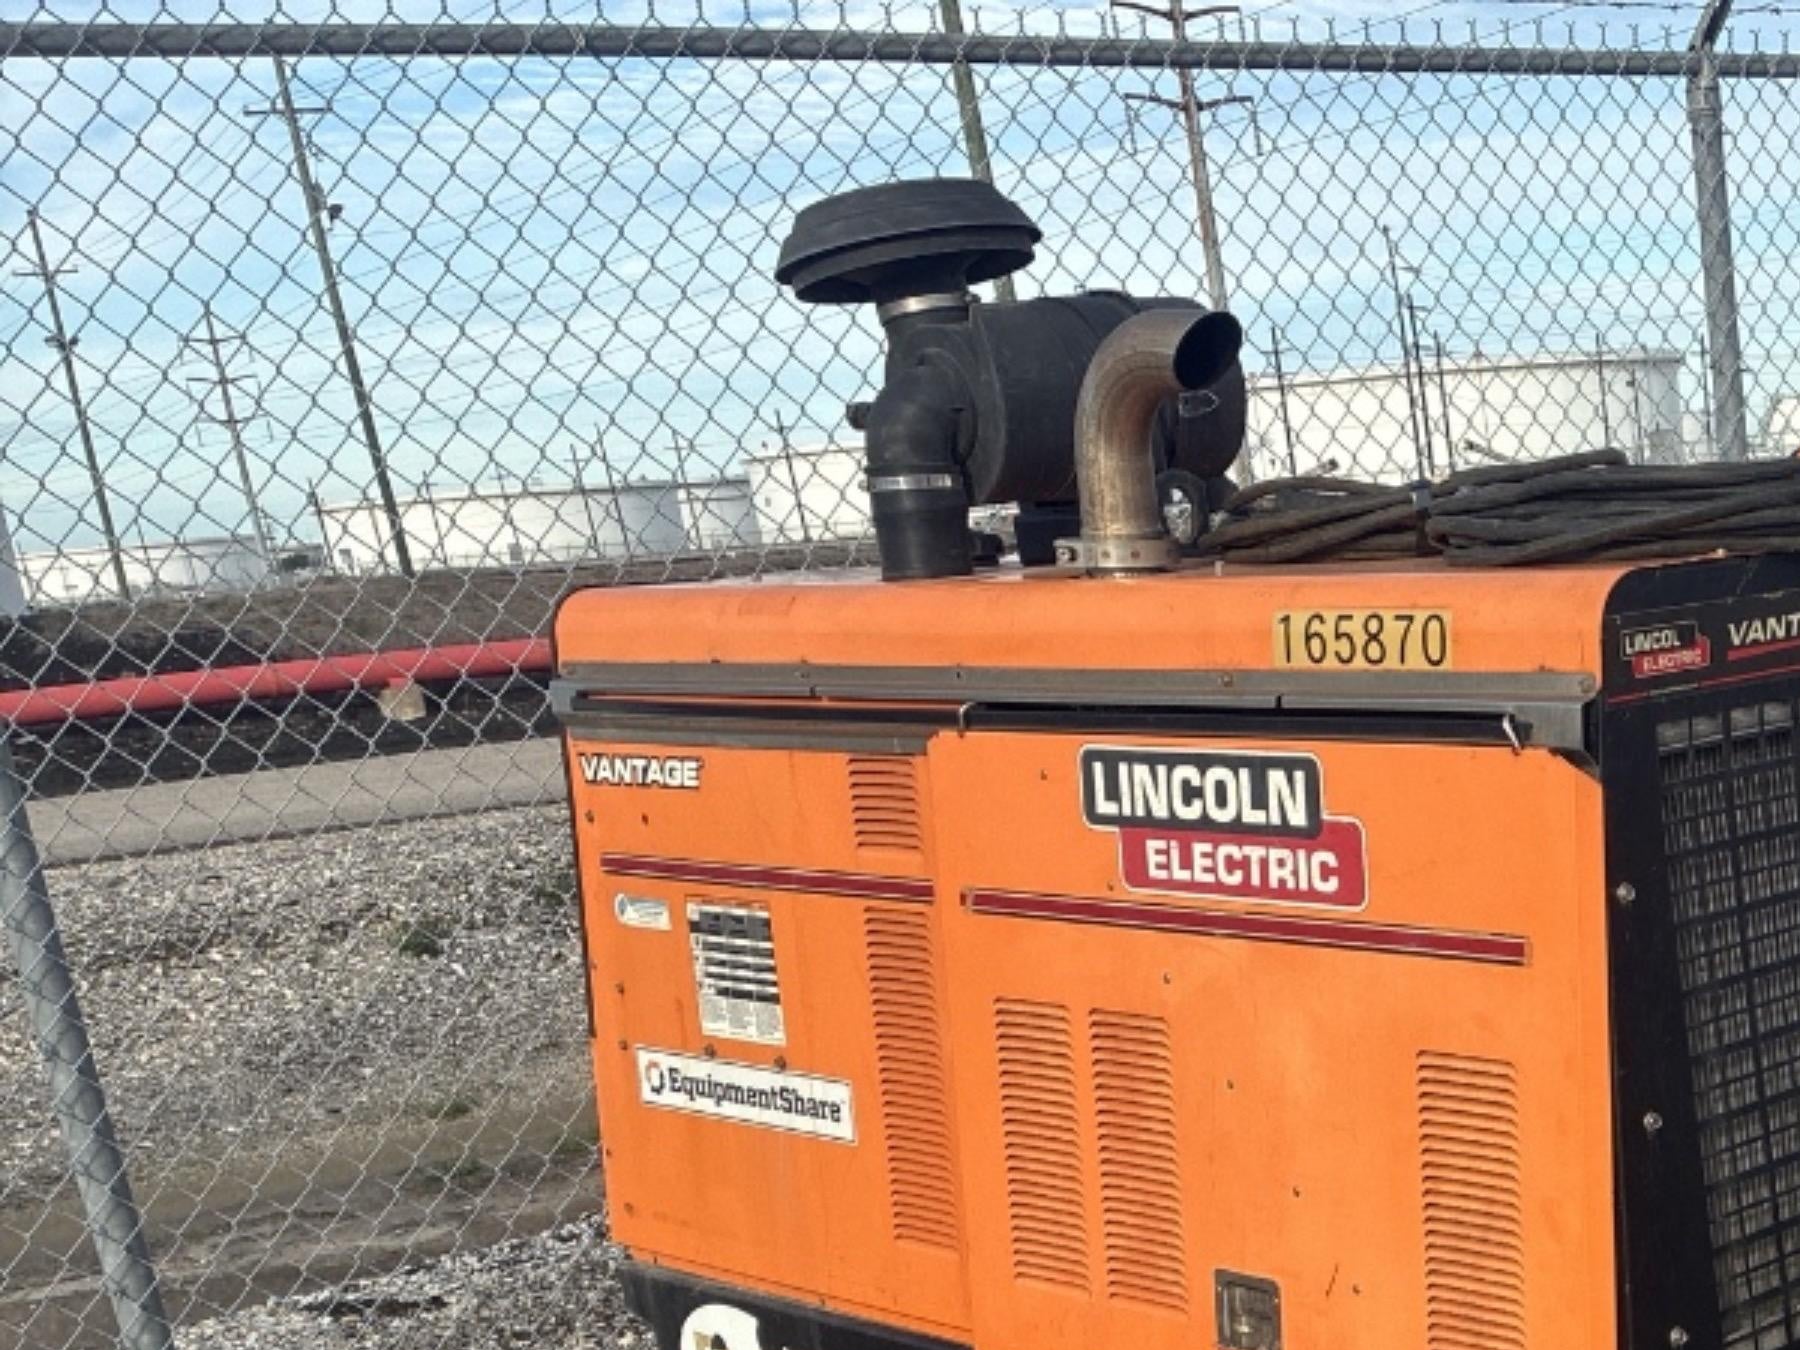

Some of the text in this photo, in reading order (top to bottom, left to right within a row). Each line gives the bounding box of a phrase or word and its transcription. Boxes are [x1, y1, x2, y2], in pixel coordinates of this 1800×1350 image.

[1278, 612, 1448, 666] 165870
[578, 754, 701, 788] VANTAGE
[1091, 760, 1308, 827] LINCOLN
[1145, 839, 1340, 893] ELECTRIC
[667, 1066, 842, 1123] EquipmentShare
